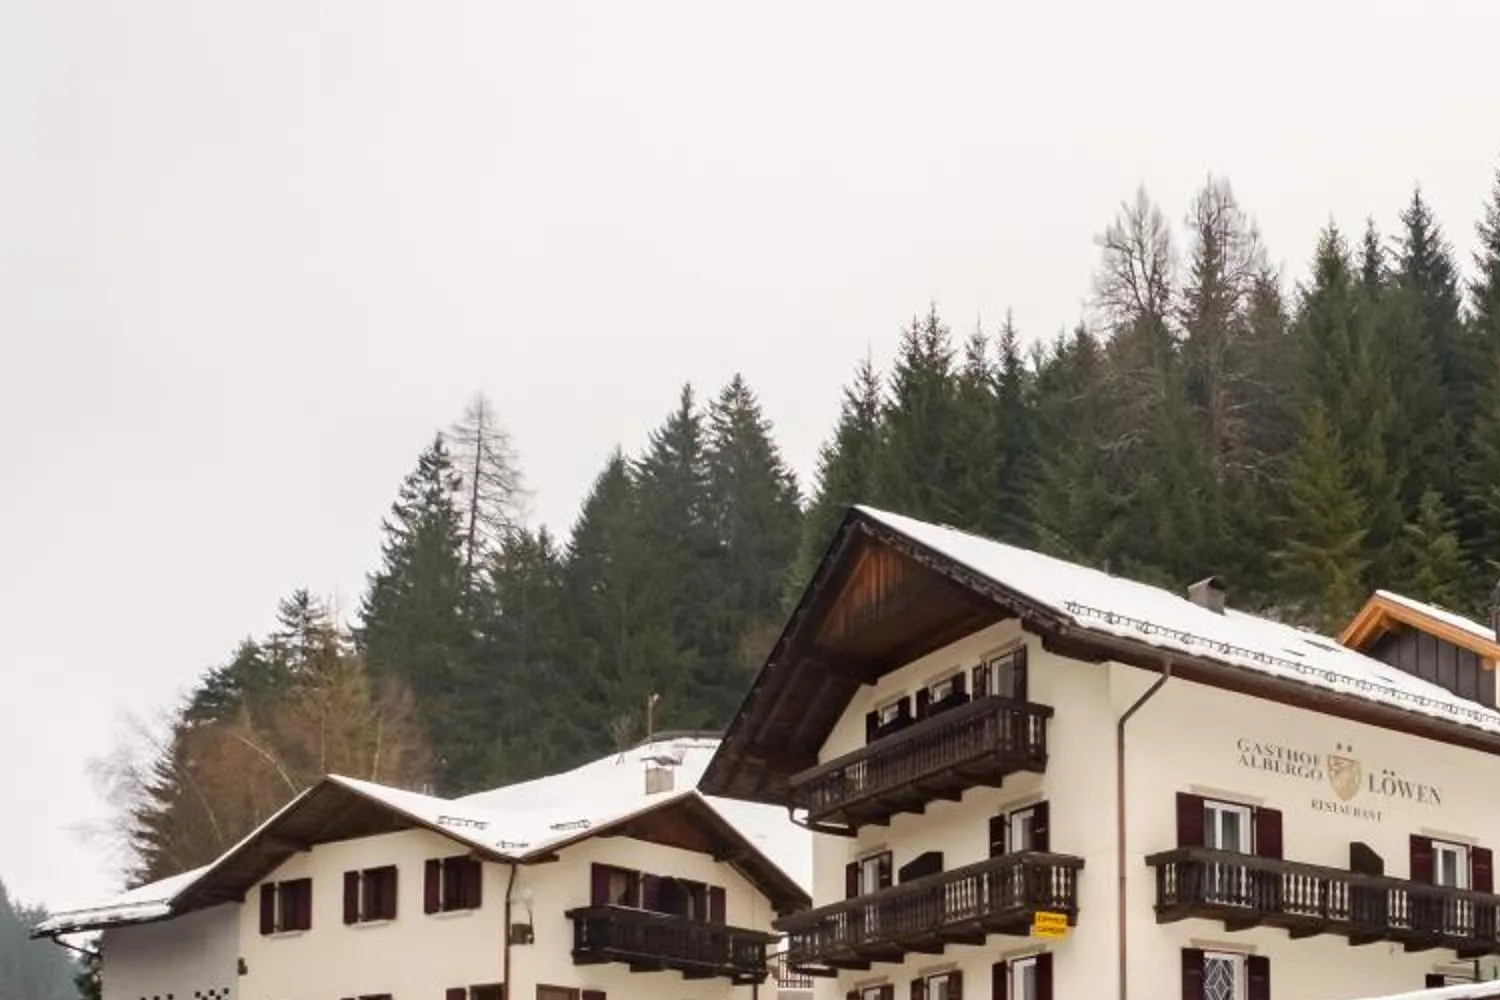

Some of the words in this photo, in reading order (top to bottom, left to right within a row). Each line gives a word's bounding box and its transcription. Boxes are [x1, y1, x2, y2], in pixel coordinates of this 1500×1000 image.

[1237, 737, 1321, 767] GASTHOF
[1238, 753, 1323, 782] ALBERGO
[1368, 768, 1442, 806] LÖWEN
